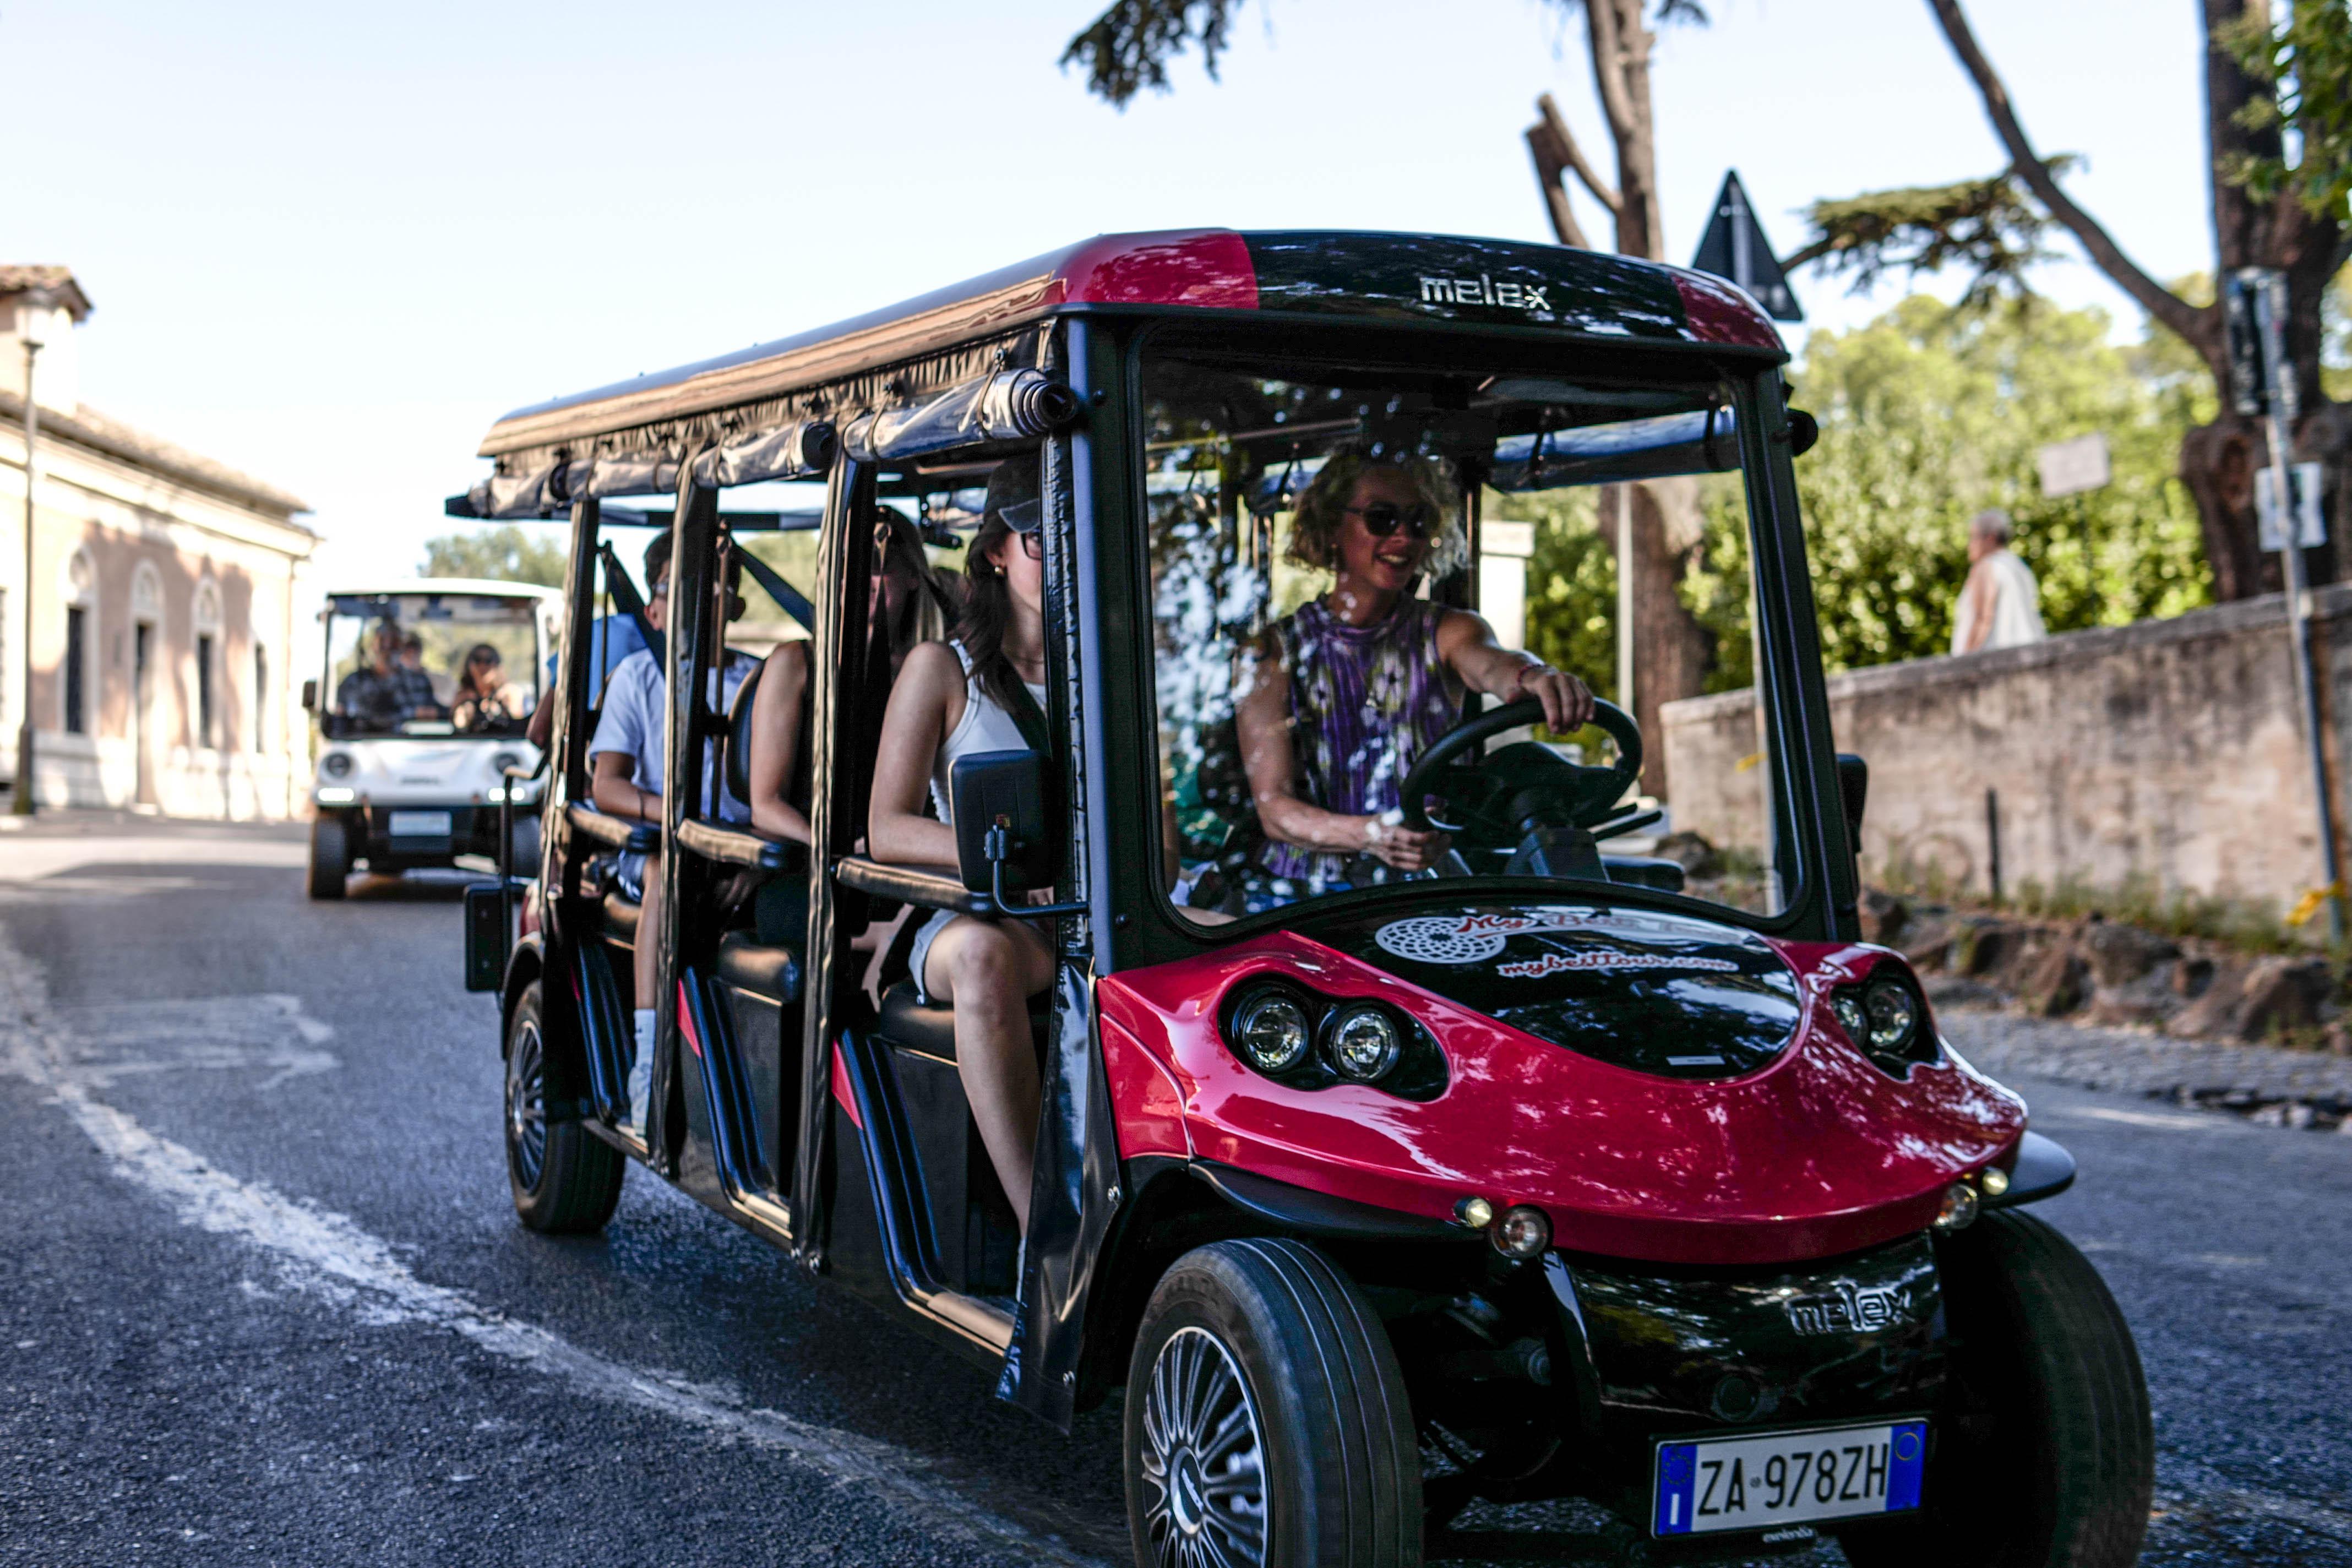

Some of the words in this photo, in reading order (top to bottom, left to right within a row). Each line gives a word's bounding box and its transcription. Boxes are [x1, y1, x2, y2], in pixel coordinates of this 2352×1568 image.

[1420, 274, 1550, 310] melex
[1456, 915, 1533, 936] My
[1500, 953, 1736, 977] mybesttour.com
[1784, 1280, 1916, 1335] melex
[1697, 1457, 1745, 1515] ZA
[1765, 1442, 1889, 1509] 978ZH
